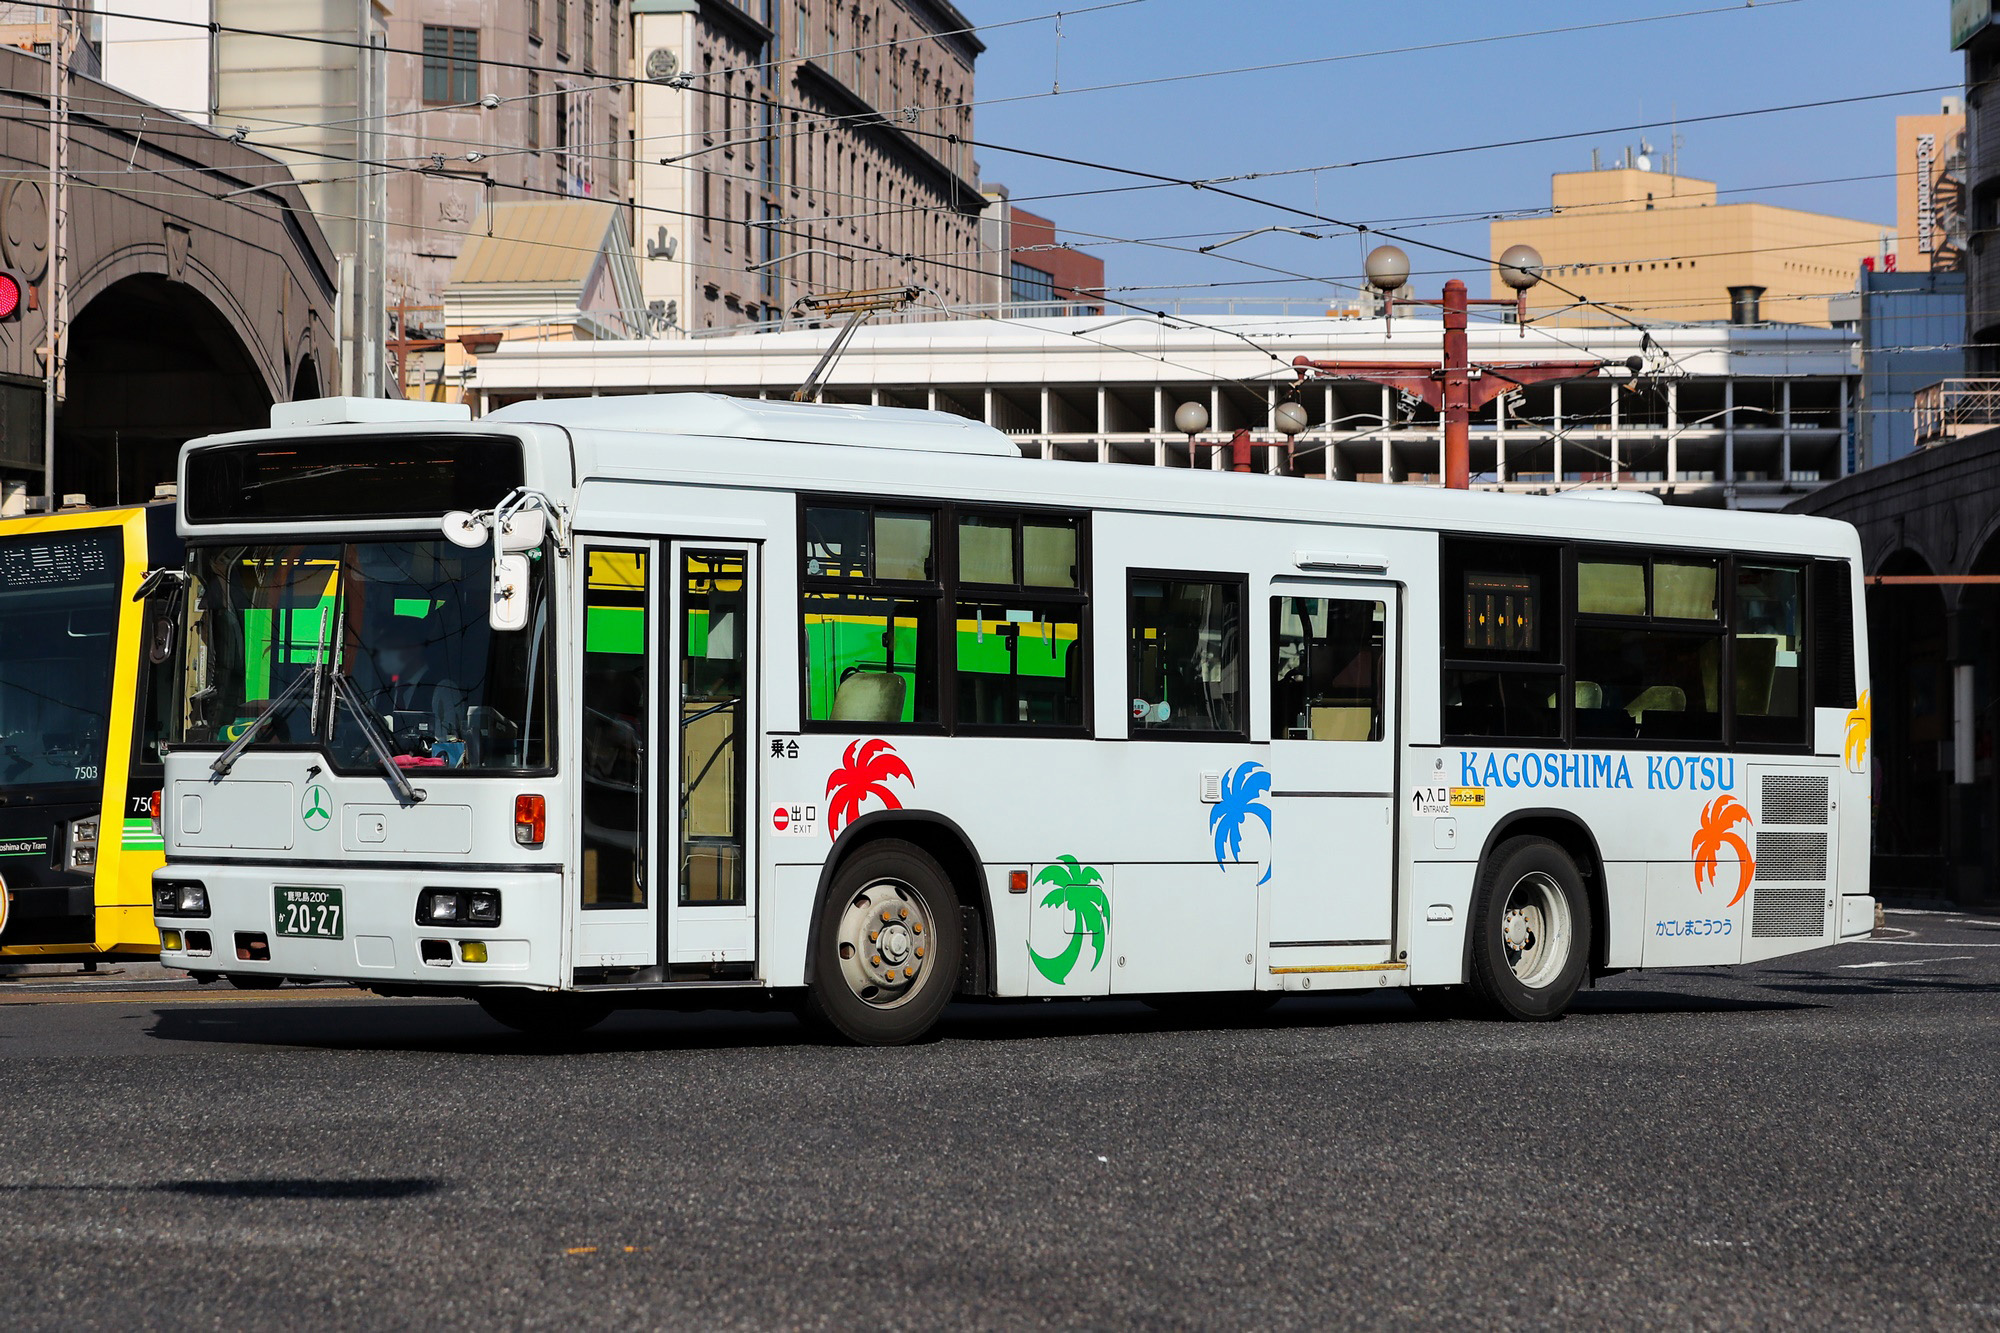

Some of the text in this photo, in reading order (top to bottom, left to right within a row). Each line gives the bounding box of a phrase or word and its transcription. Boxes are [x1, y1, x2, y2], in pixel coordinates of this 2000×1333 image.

[771, 739, 799, 758] 乗合
[75, 766, 98, 779] 7503
[1460, 752, 1734, 790] KAGOSHIMA KOTSU
[1426, 788, 1446, 802] 入口
[791, 805, 816, 821] 出口
[1423, 805, 1449, 813] ENTRANCE
[793, 825, 812, 833] EXIT
[20, 842, 32, 852] City
[32, 841, 47, 850] Tram
[1656, 918, 1732, 936] かごしまこうつう
